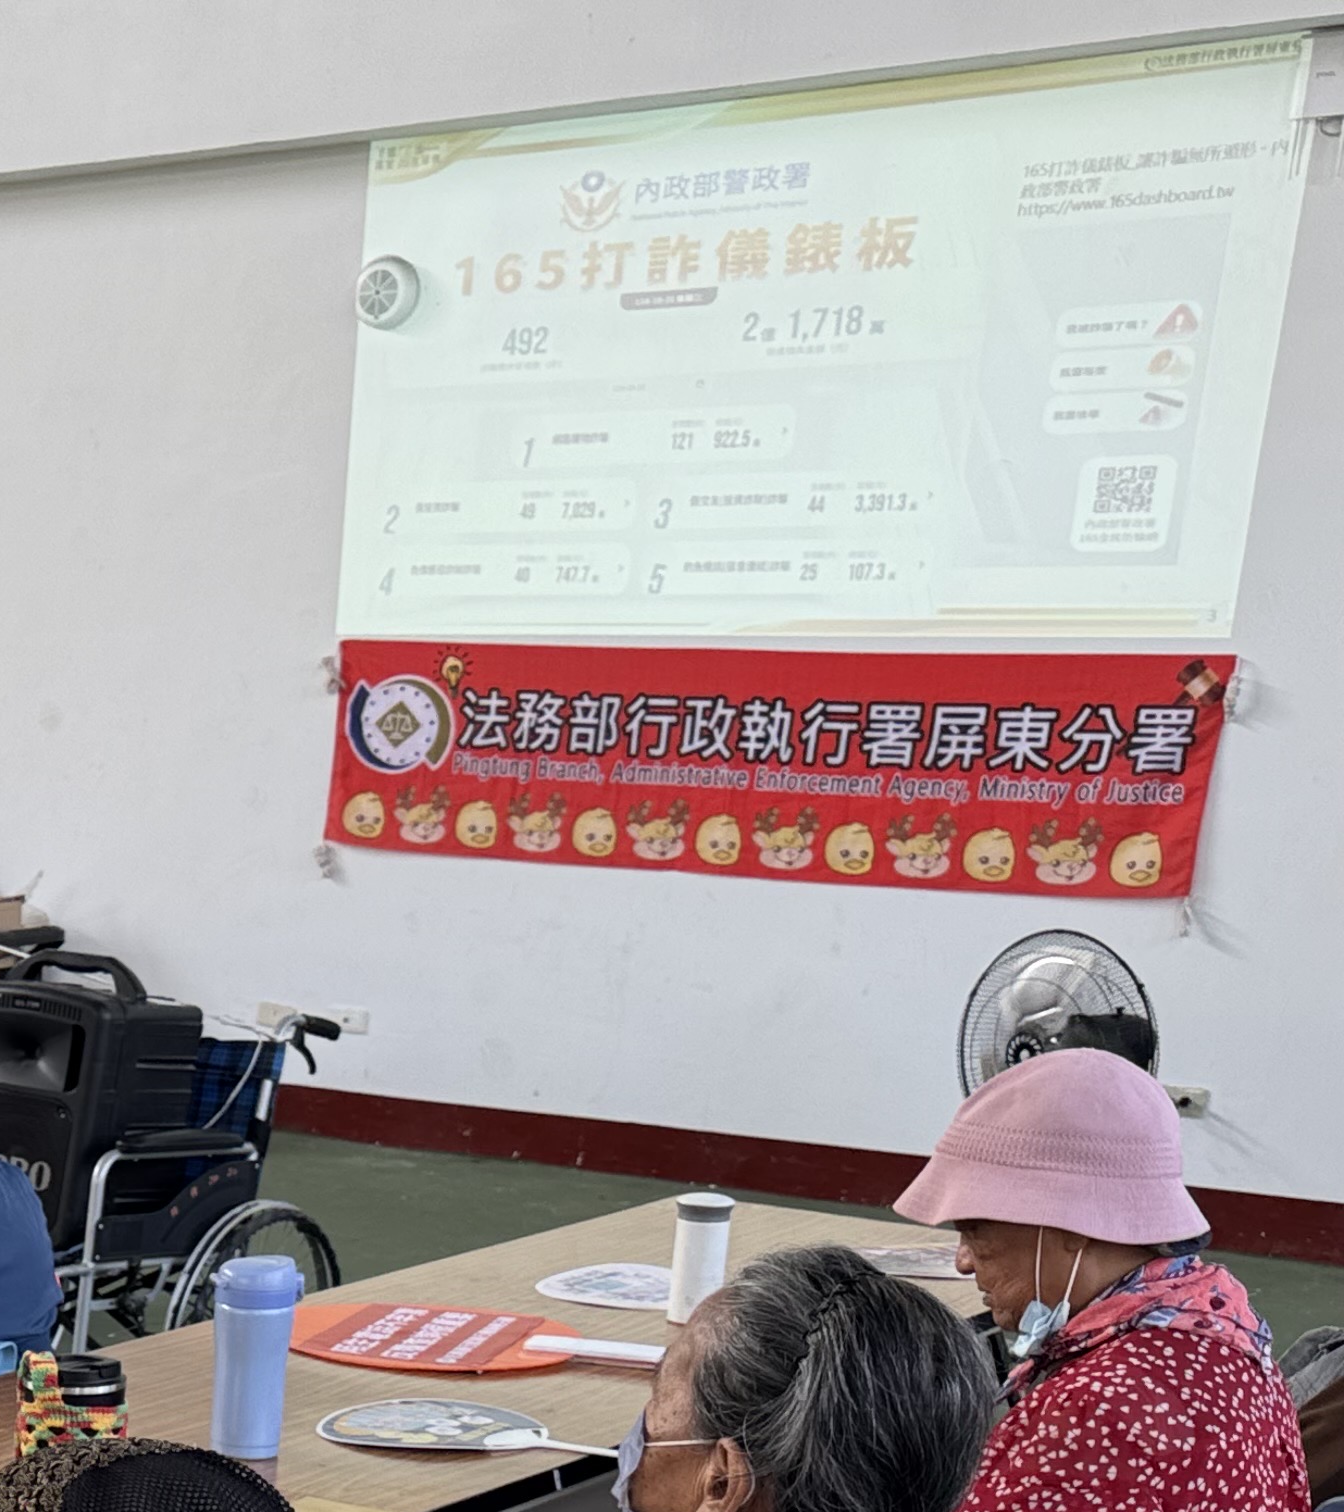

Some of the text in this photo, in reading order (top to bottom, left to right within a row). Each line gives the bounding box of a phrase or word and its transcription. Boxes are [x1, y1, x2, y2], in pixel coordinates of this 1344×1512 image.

[634, 163, 810, 203] 內政部警政署
[1017, 185, 1236, 217] https://www.165dashboard.tw
[455, 216, 918, 297] 165打詐儀錶板
[502, 326, 549, 356] 492
[383, 504, 401, 535] 2
[654, 498, 673, 529] 3
[378, 567, 396, 596] 4
[648, 563, 667, 594] 5
[458, 689, 1195, 774] 法務部行政執行署屏東分署
[452, 753, 1184, 806] Pingtung Branch, Administrative Enforcement Agency, Ministry of Justice
